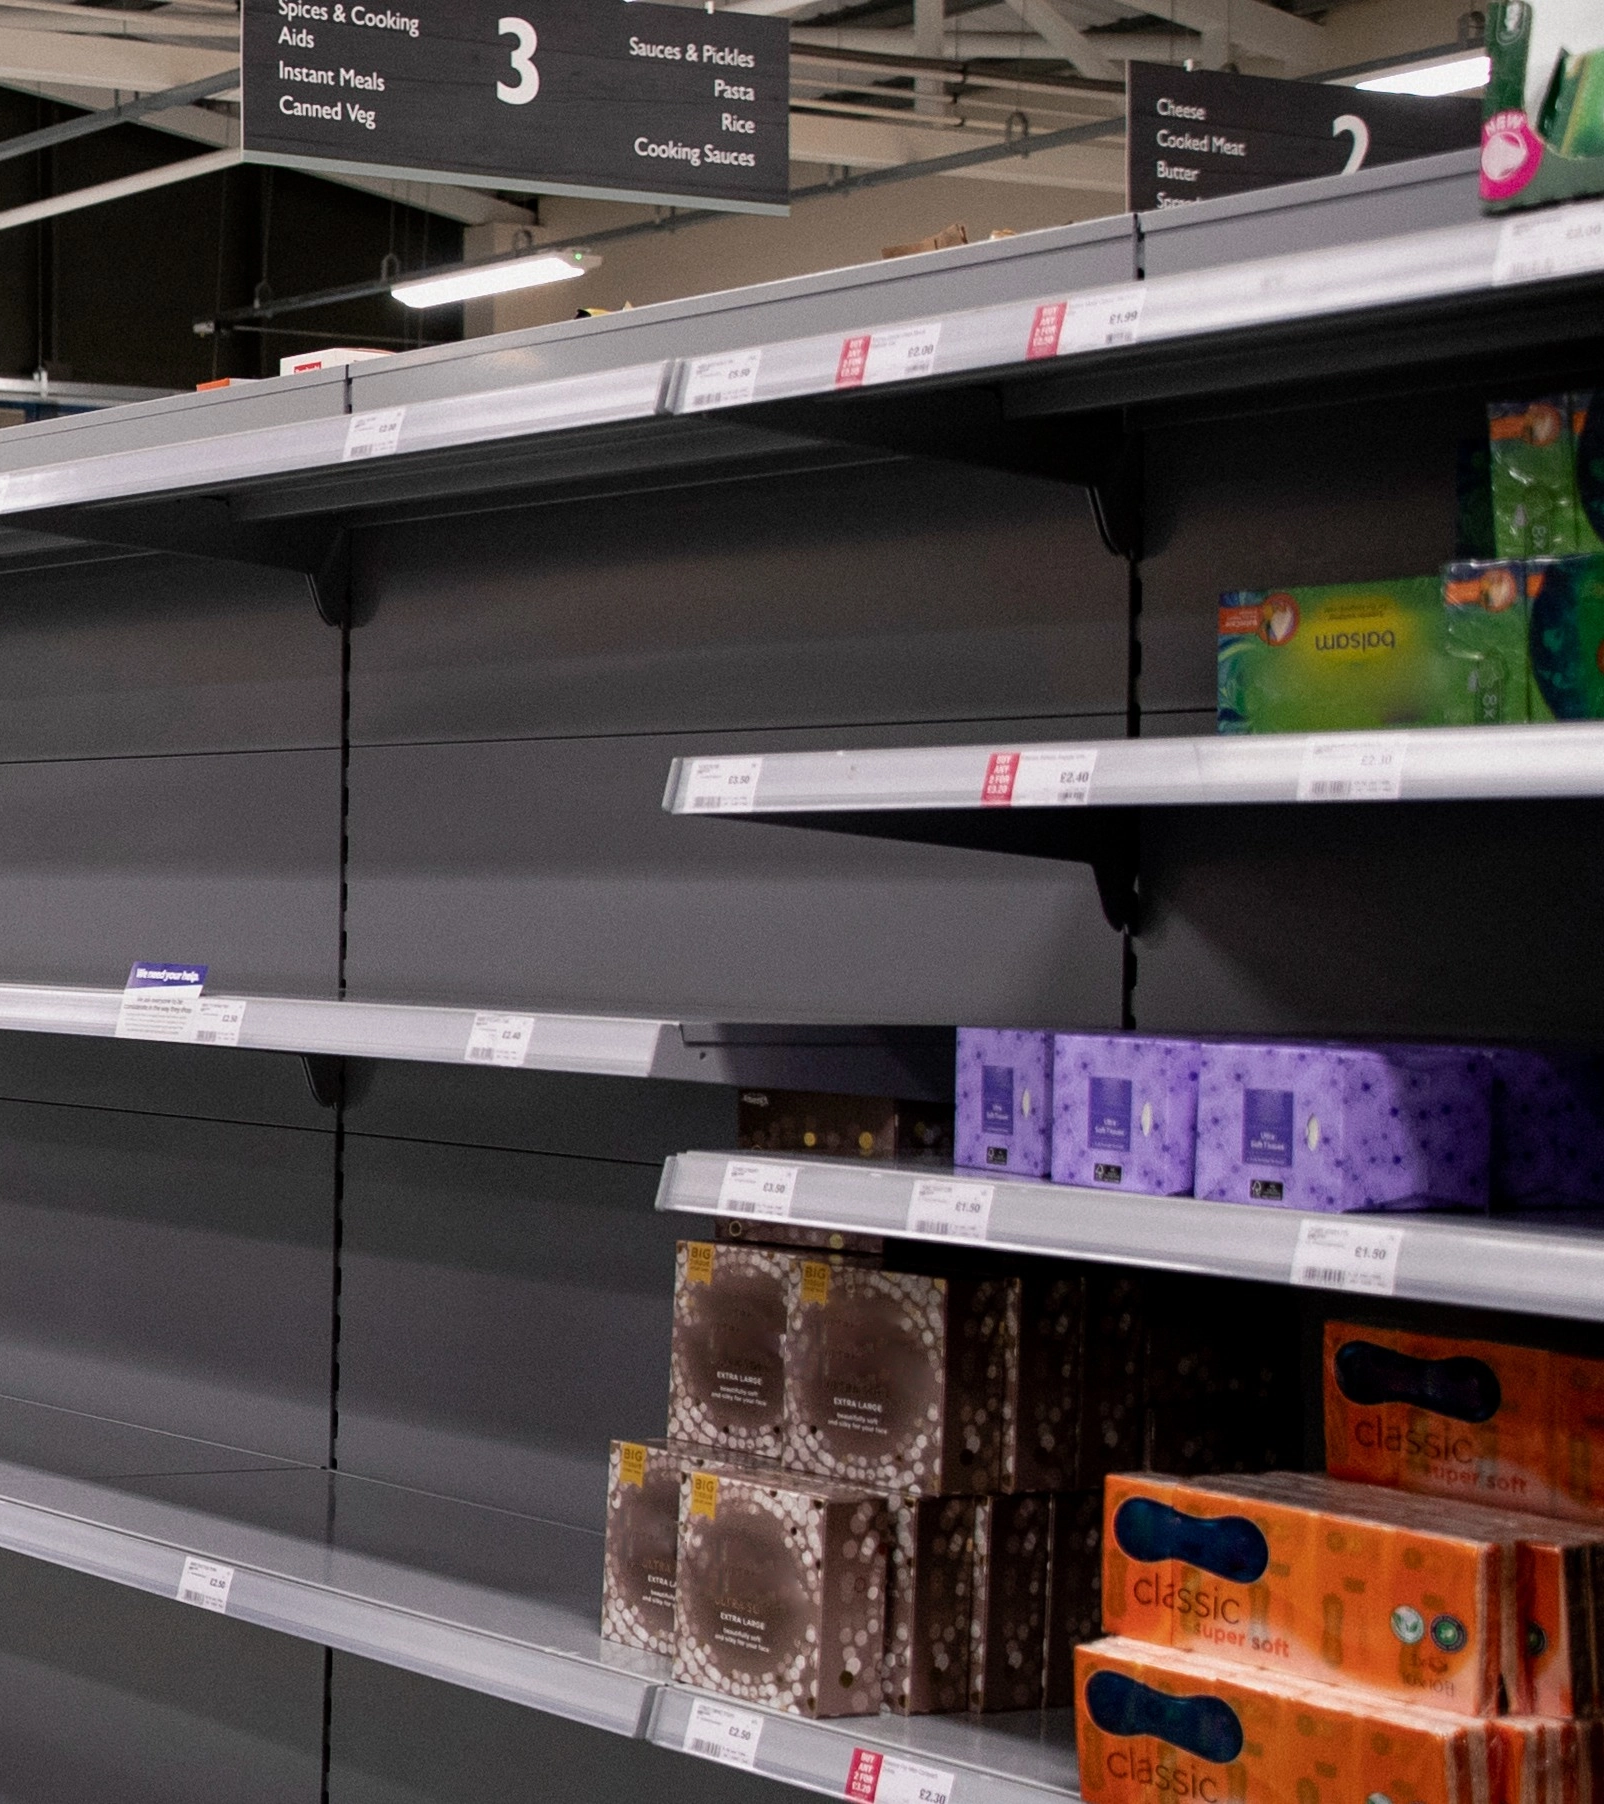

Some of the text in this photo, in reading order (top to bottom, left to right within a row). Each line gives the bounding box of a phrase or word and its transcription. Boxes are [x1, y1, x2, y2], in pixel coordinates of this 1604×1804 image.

[278, 0, 420, 38] Spices & Cooking
[278, 26, 315, 48] Aids
[496, 16, 540, 105] 3
[629, 36, 755, 68] Sauces & Pickles
[279, 61, 385, 91] Instant Meals
[714, 79, 755, 101] Pasta
[279, 95, 376, 130] Canned Veg
[1156, 98, 1206, 121] Cheese
[721, 112, 756, 133] Rice
[1485, 113, 1525, 137] NEW
[634, 137, 756, 166] Cooking Sauces
[1156, 129, 1245, 157] Cooked Meat
[1156, 160, 1200, 182] Butter
[908, 344, 934, 358] £2.00
[1314, 629, 1396, 653] balsam
[728, 775, 750, 785] £3.50
[1060, 771, 1089, 783] £2.40
[136, 968, 147, 978] We
[147, 970, 164, 980] need
[164, 970, 182, 982] your
[763, 1182, 785, 1194] £3.50
[955, 1201, 981, 1213] £1.50
[690, 1248, 711, 1260] BIG
[1354, 1246, 1386, 1260] £1.50
[804, 1266, 826, 1279] BIG
[716, 1371, 763, 1386] EXTRA LARGE
[833, 1396, 883, 1413] EXTRA LARGE
[624, 1448, 643, 1462] BIG
[695, 1478, 715, 1492] BIG
[1487, 1474, 1527, 1493] soft
[647, 1574, 668, 1586] EXTRA
[720, 1612, 766, 1631] EXTRA LARGE
[1195, 1622, 1290, 1658] super soft
[728, 1726, 751, 1741] £2.50
[860, 1752, 875, 1764] BUY
[858, 1763, 874, 1773] ANY
[854, 1771, 874, 1785] 2 FOR
